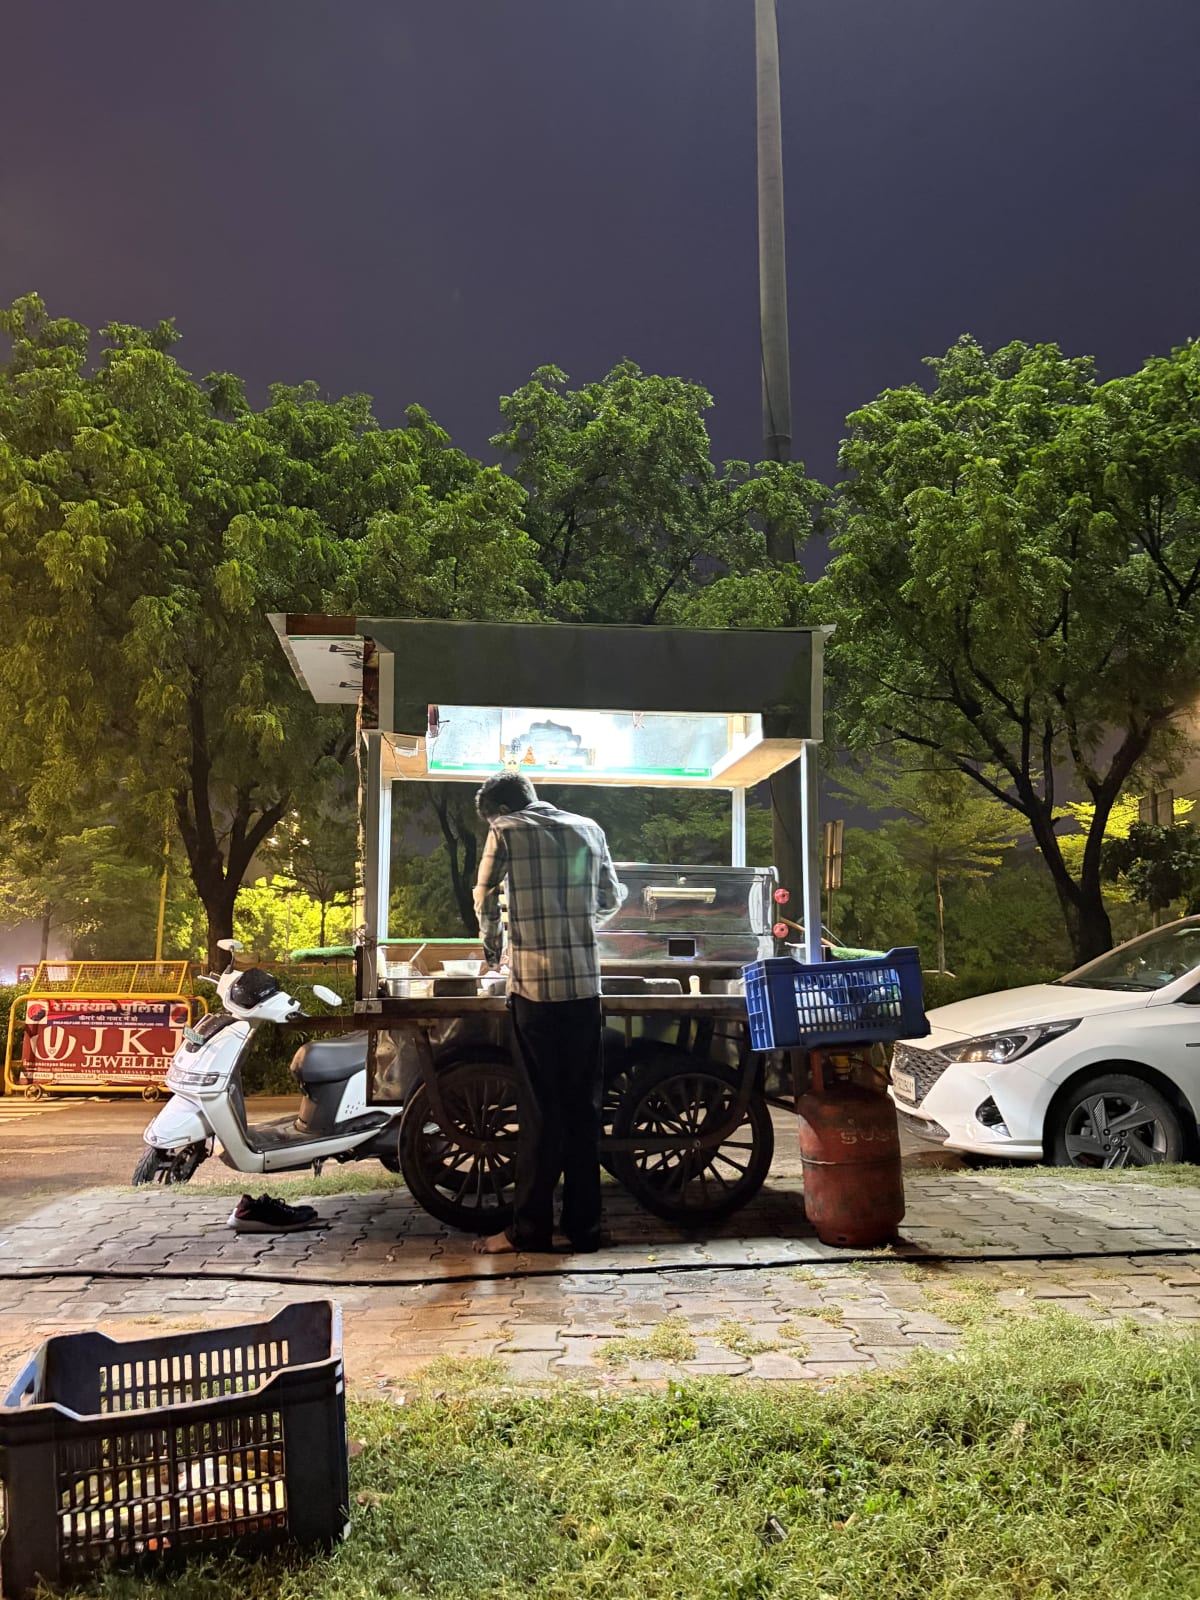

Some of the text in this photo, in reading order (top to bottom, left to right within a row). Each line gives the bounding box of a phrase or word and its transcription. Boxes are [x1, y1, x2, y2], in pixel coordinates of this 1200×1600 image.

[53, 1001, 167, 1015] राजस्थान पुलिस
[81, 1055, 174, 1069] JEWELLER
